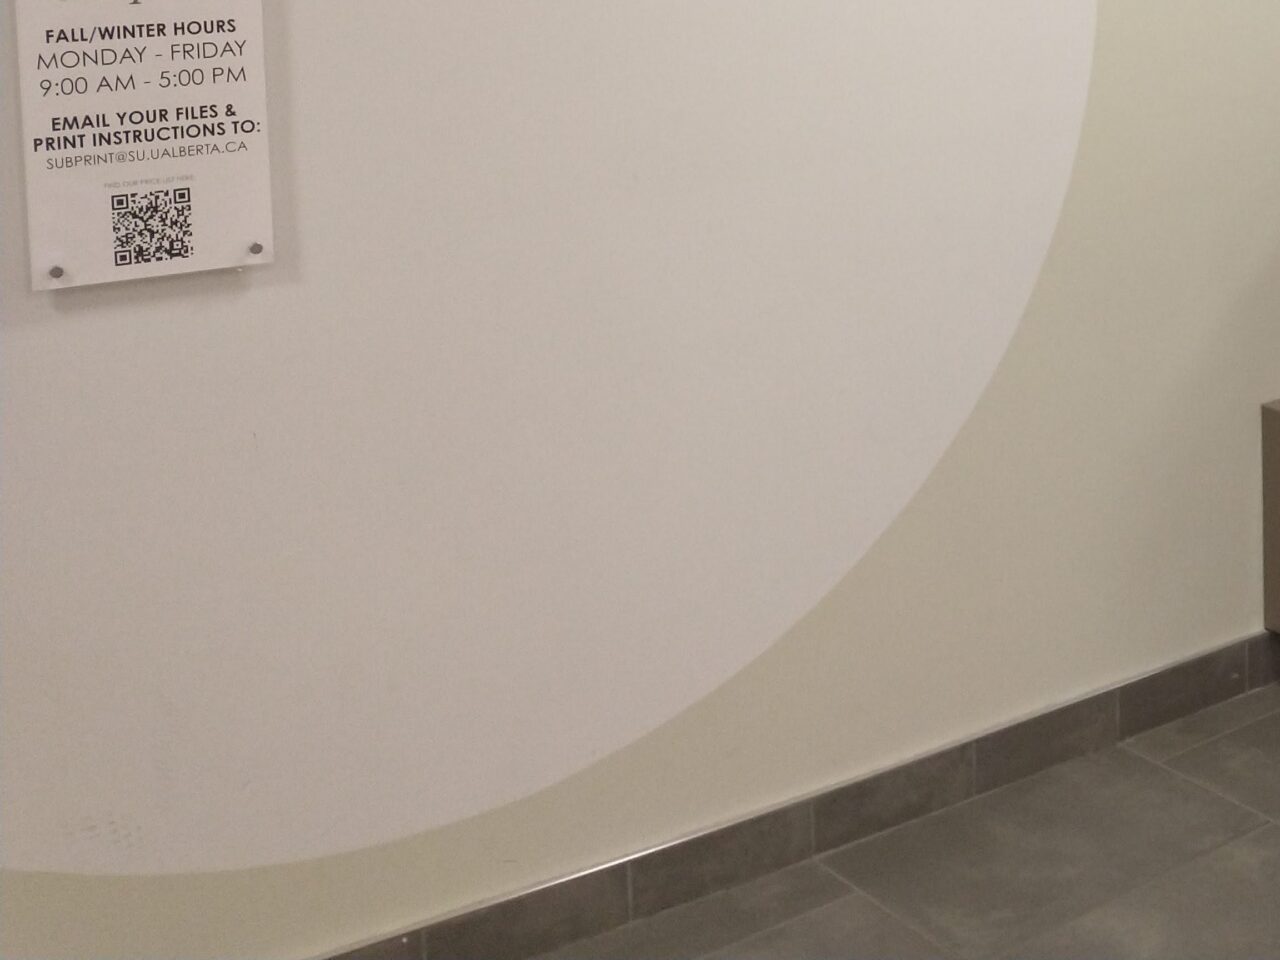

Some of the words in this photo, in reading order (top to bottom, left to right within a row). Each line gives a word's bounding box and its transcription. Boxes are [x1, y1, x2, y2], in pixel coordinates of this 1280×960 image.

[45, 22, 167, 44] FALL/WINTER
[173, 19, 237, 36] HOURS
[37, 46, 147, 70] MONDAY
[170, 40, 247, 61] FRIDAY
[39, 76, 88, 97] 9:00
[96, 74, 136, 93] AM
[158, 68, 204, 88] 5:00
[212, 66, 247, 83] PM
[51, 114, 110, 132] EMAIL
[116, 108, 169, 126] YOUR
[175, 104, 218, 121] FILES
[225, 103, 237, 117] &
[33, 134, 85, 152] PRINT
[92, 122, 226, 147] INSTRUCTIONS
[231, 119, 261, 135] TO:
[46, 141, 248, 170] SUBPRINT@SU.UALBERTA.CA
